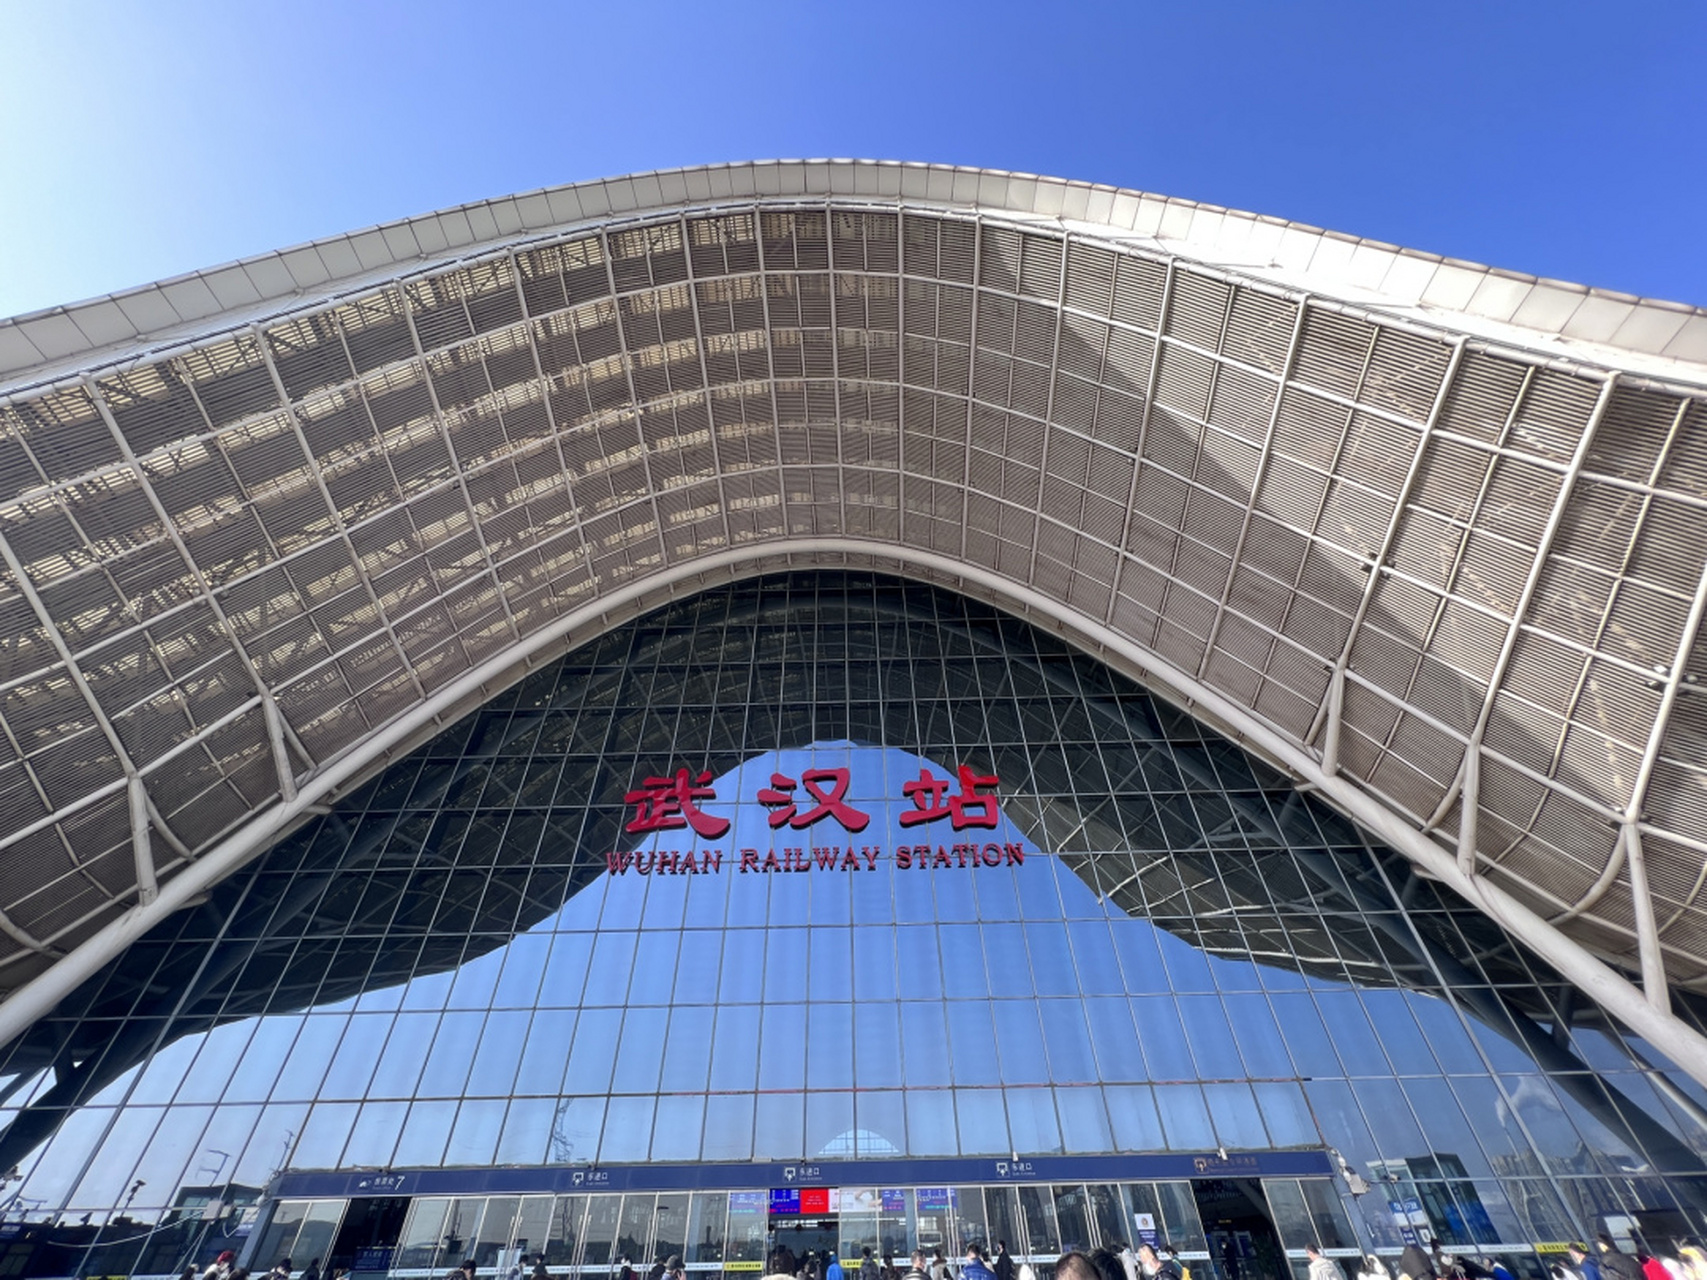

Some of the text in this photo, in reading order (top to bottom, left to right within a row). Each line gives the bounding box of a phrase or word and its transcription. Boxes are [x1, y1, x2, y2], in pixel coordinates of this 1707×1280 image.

[624, 764, 999, 838] 武汉站
[606, 843, 1025, 875] WUHAN RAILWAY STATION
